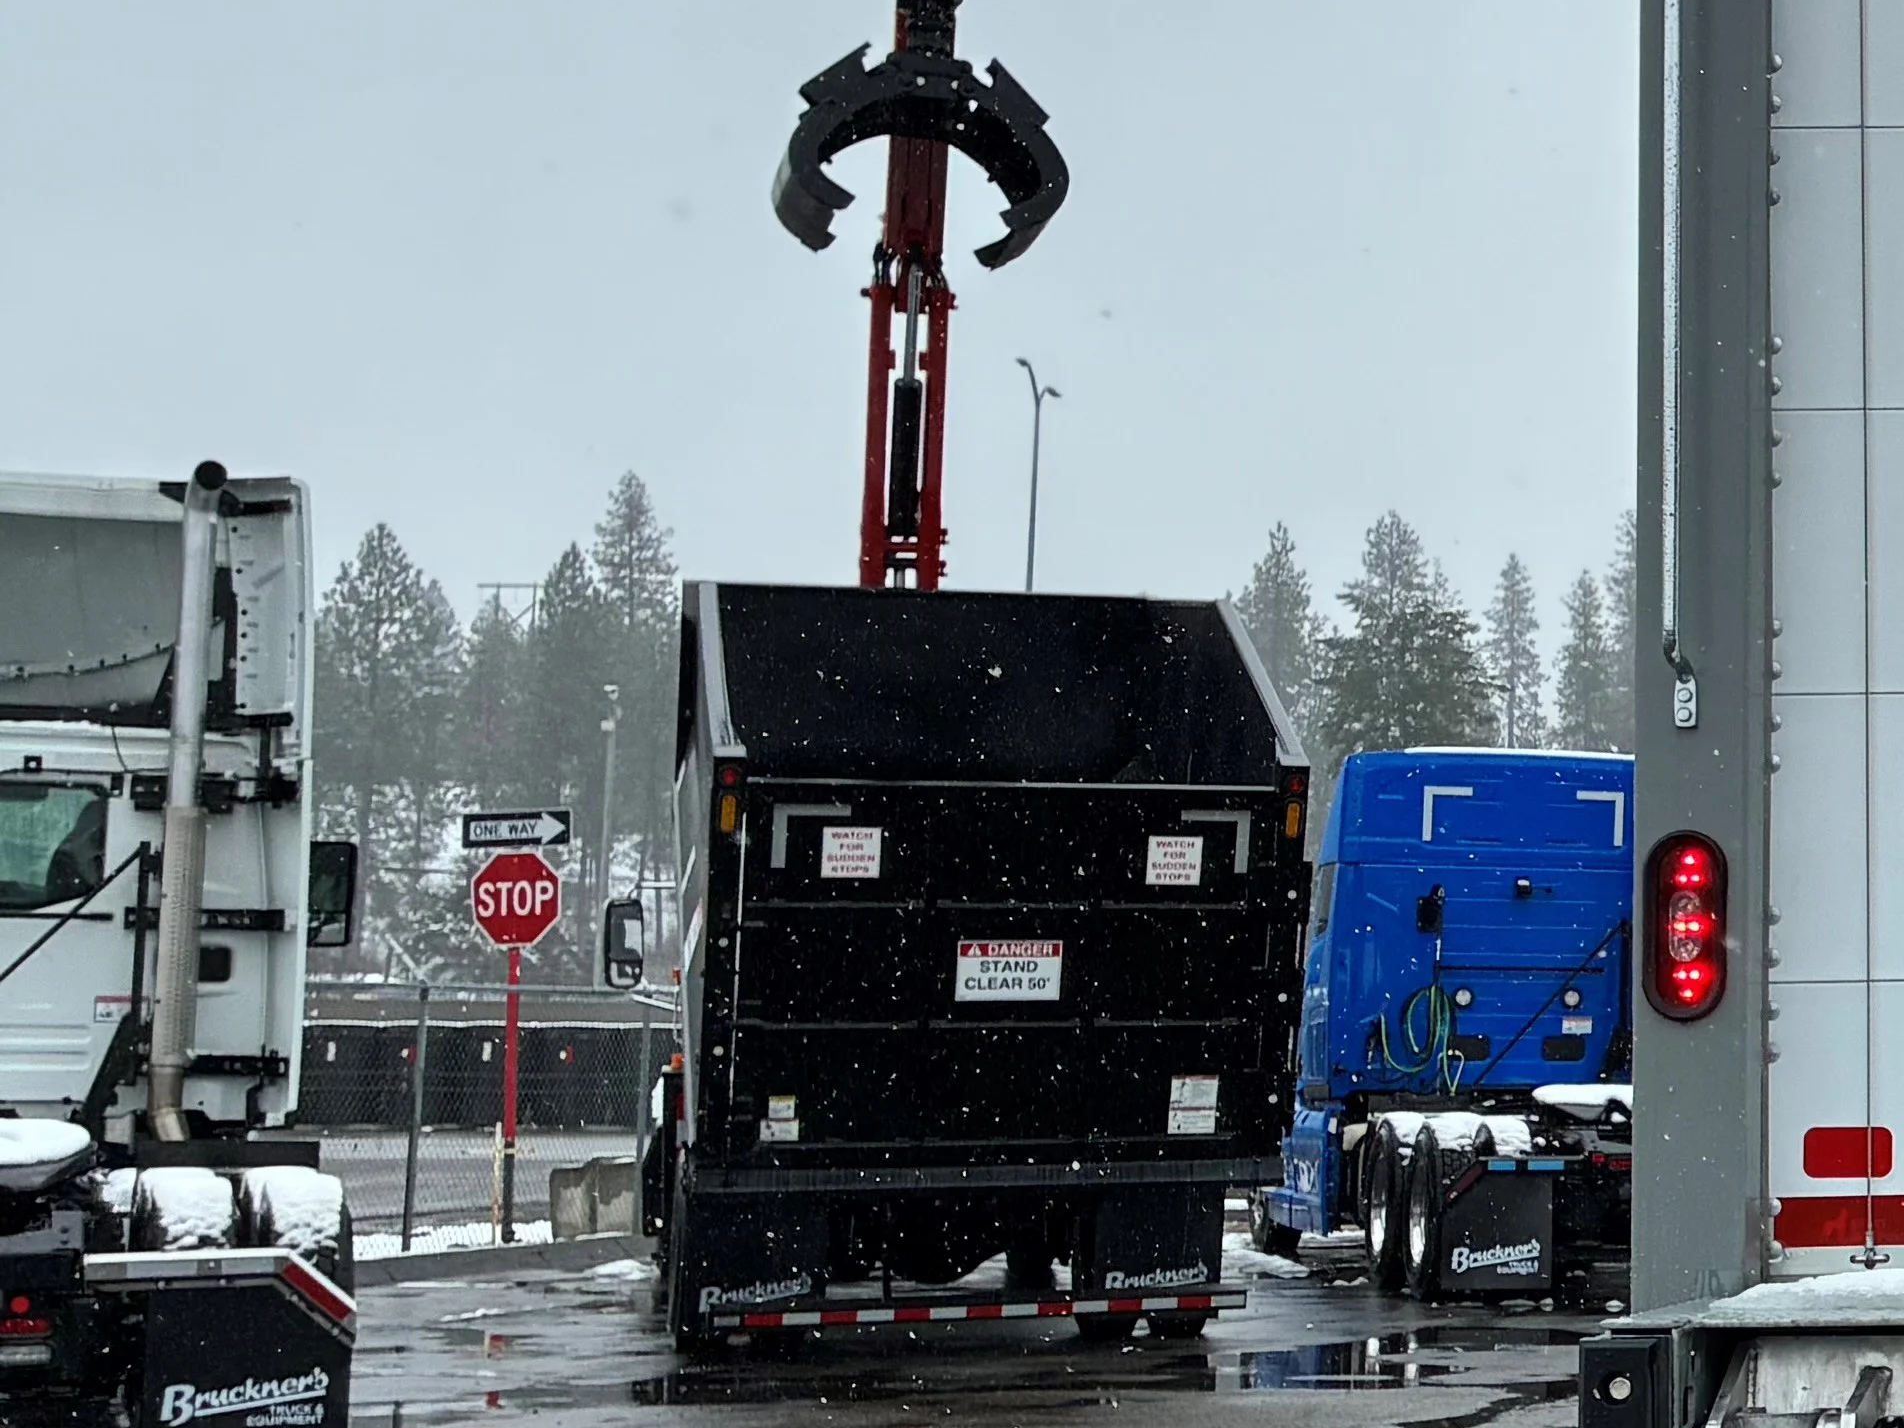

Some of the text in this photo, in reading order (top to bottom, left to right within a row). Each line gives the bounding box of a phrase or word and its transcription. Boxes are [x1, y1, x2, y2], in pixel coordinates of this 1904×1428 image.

[473, 822, 537, 837] ONE WAY
[1156, 840, 1195, 848] WATCH
[1163, 851, 1186, 859] FOR
[1151, 862, 1196, 871] SUDDEN
[1155, 873, 1191, 881] STOPS
[477, 880, 554, 917] STOP
[988, 943, 1053, 956] DANGER
[980, 960, 1038, 973] STAND
[964, 977, 1022, 990] CLEAR
[1451, 1239, 1540, 1273] Bruckner's
[160, 1367, 329, 1427] Bruckner's
